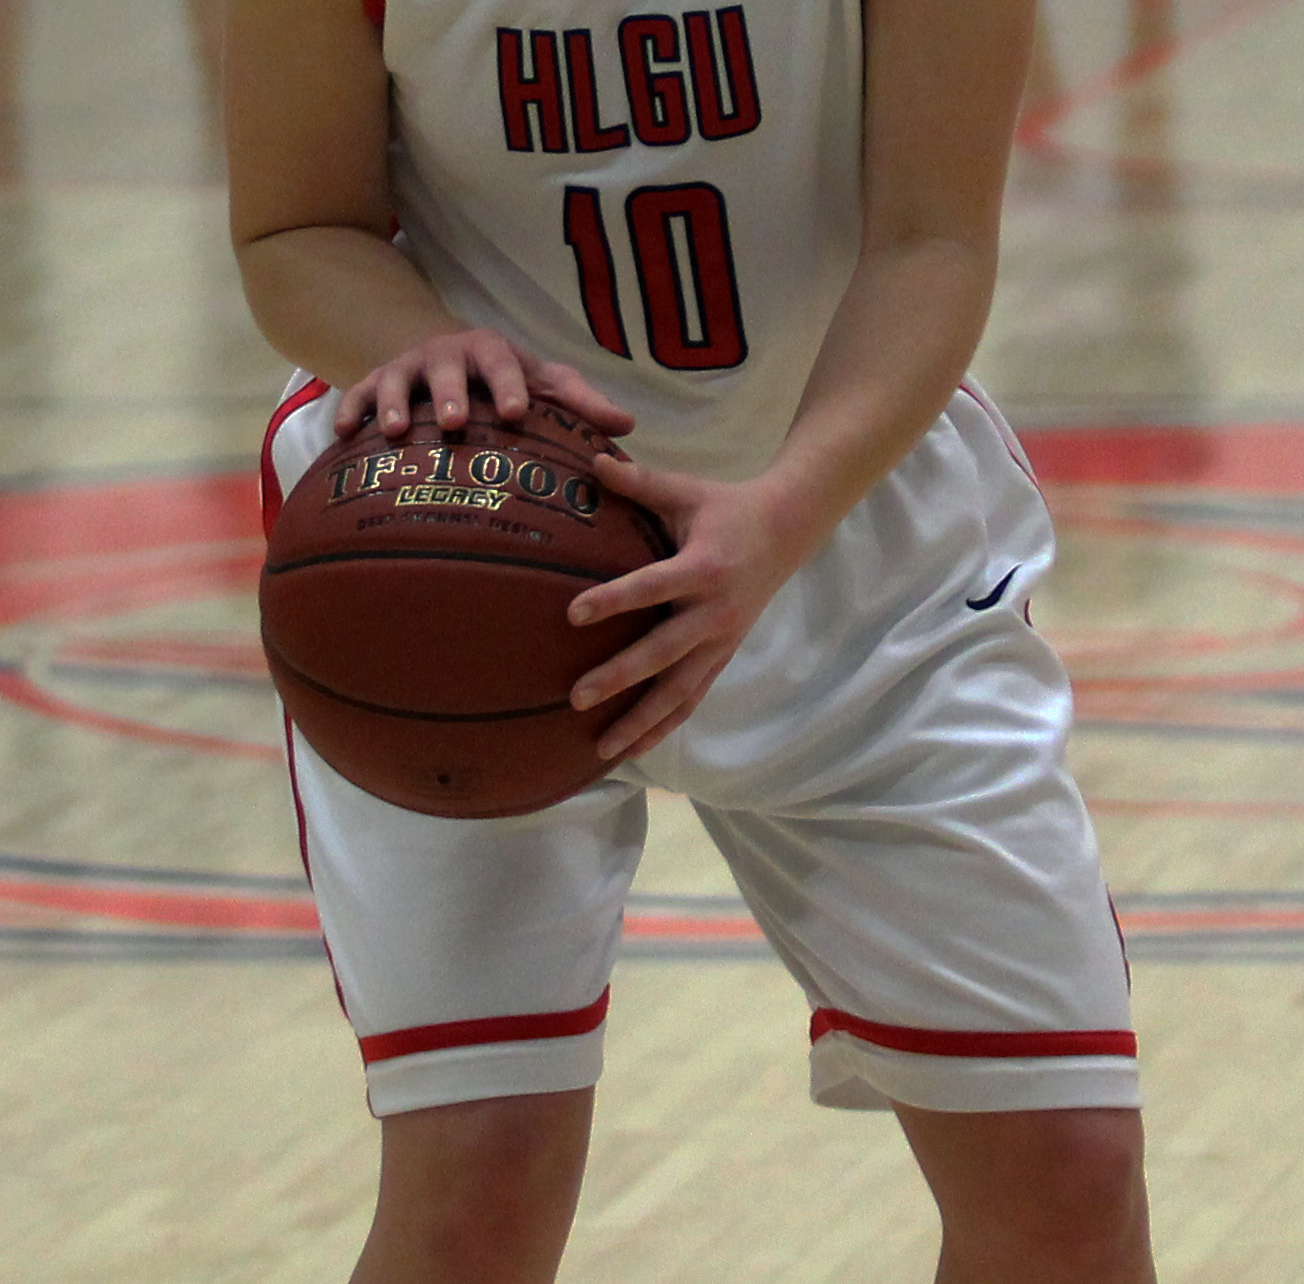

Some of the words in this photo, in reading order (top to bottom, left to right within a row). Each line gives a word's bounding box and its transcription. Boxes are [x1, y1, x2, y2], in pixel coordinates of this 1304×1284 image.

[496, 4, 763, 154] HLGU
[563, 181, 749, 371] 10
[327, 447, 600, 517] TF-1000
[395, 484, 513, 511] LEGACY
